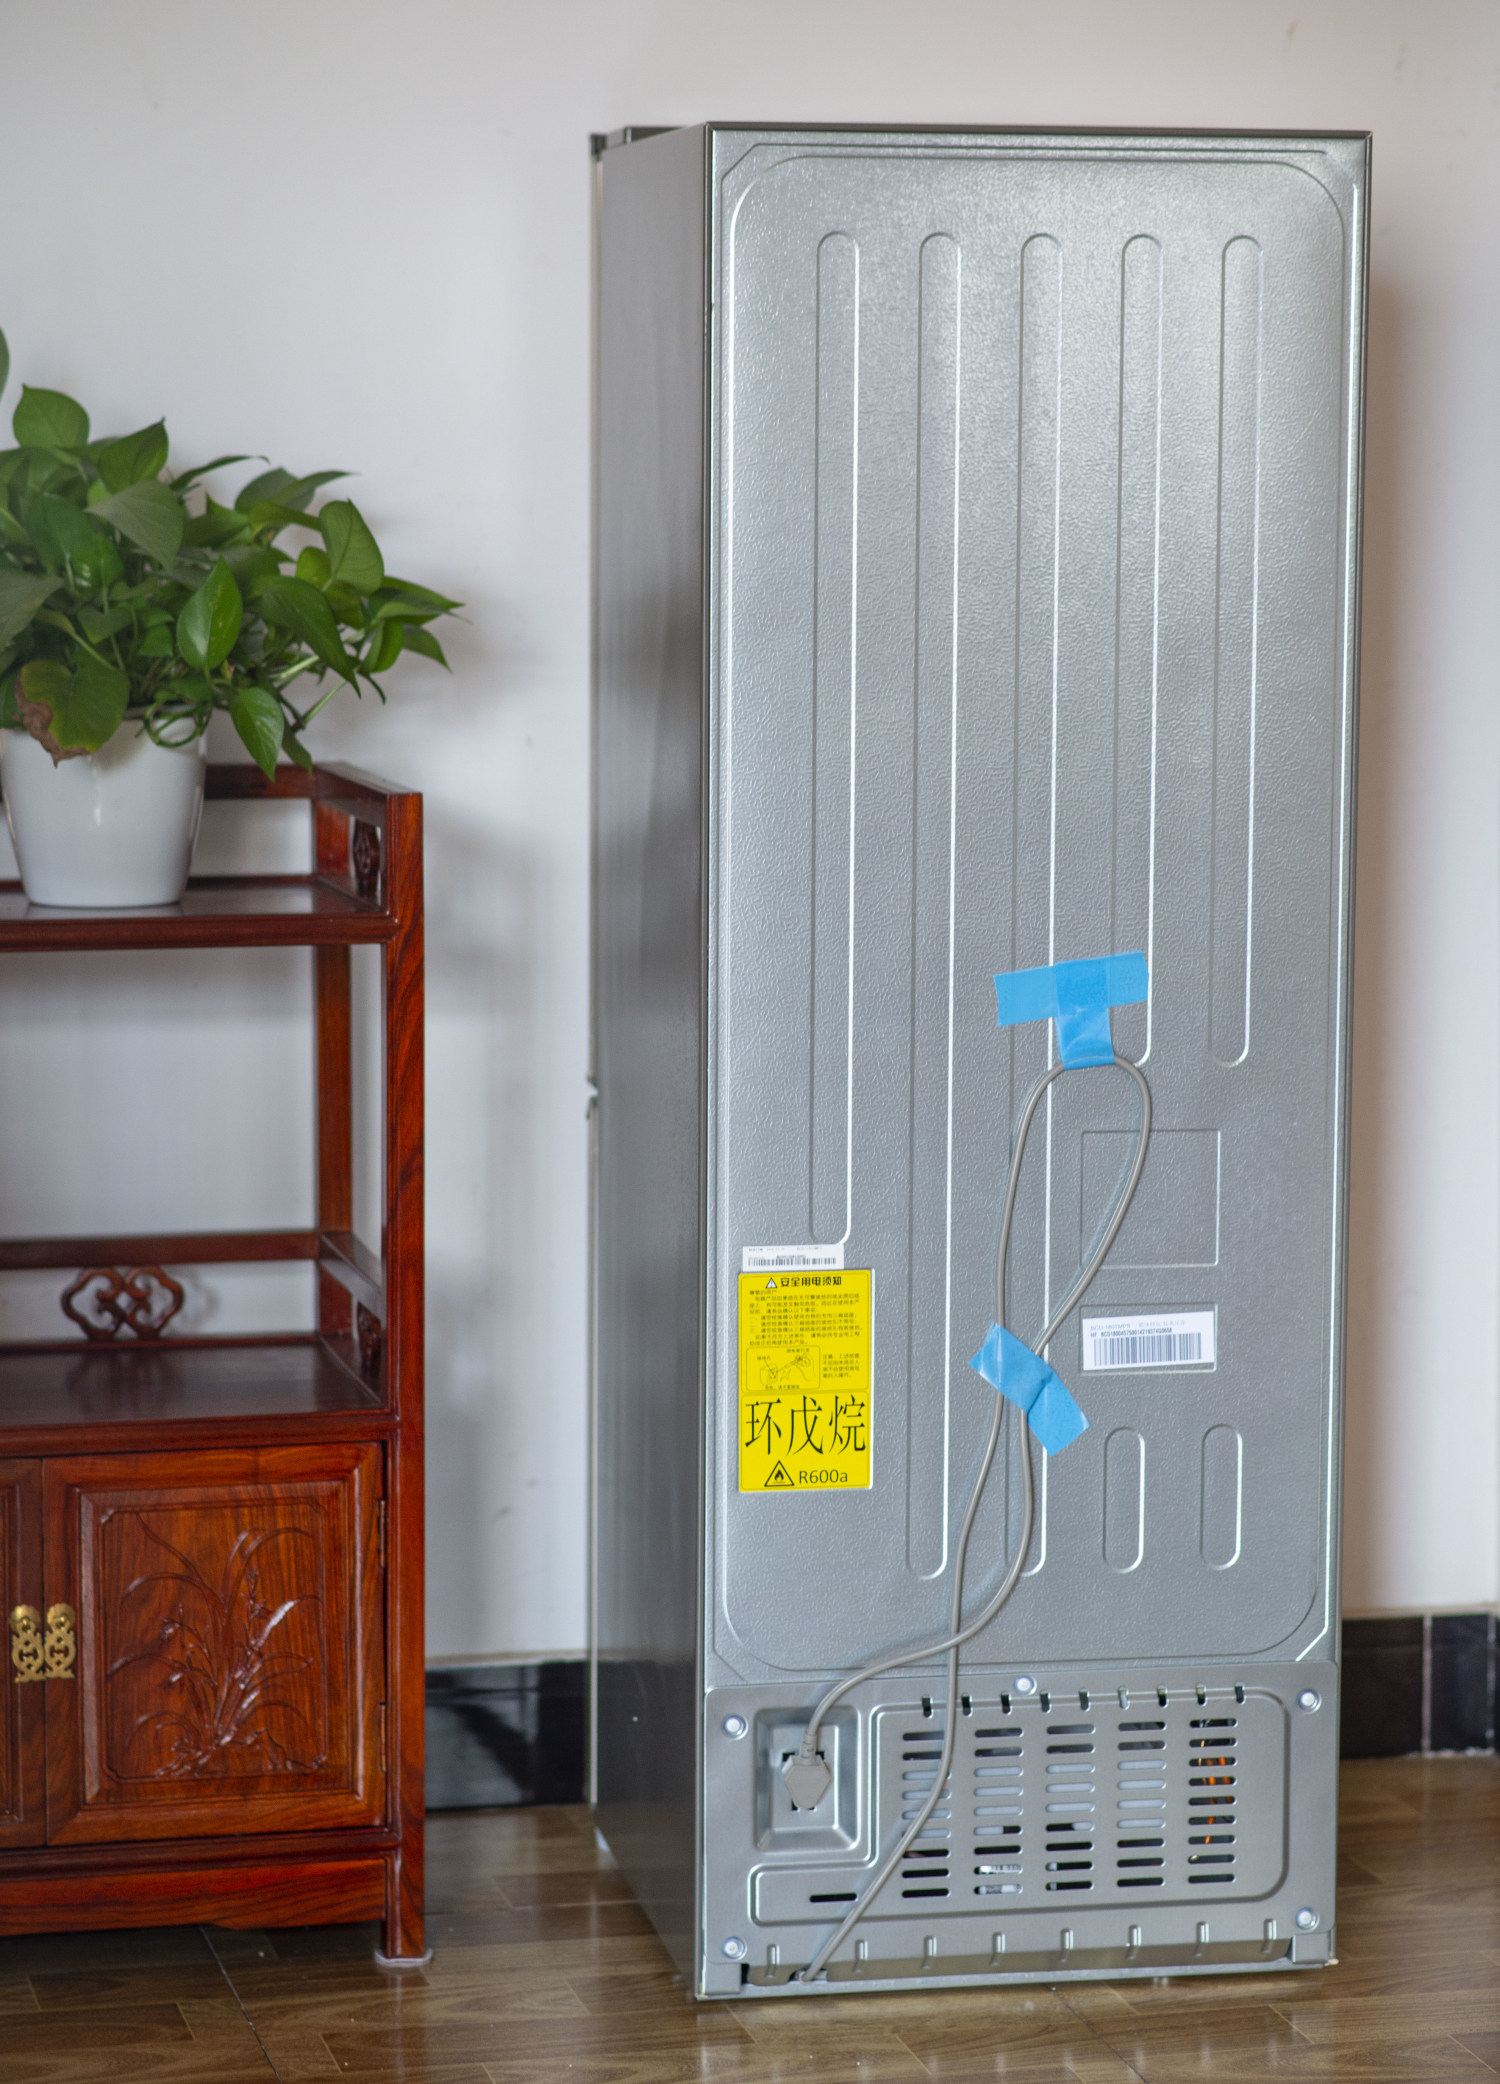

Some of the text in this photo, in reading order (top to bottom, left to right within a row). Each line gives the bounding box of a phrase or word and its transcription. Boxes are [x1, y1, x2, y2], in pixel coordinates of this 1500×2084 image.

[780, 1276, 842, 1287] 安全用电须知
[745, 1394, 866, 1456] 环戊烷
[799, 1469, 848, 1484] R600a
